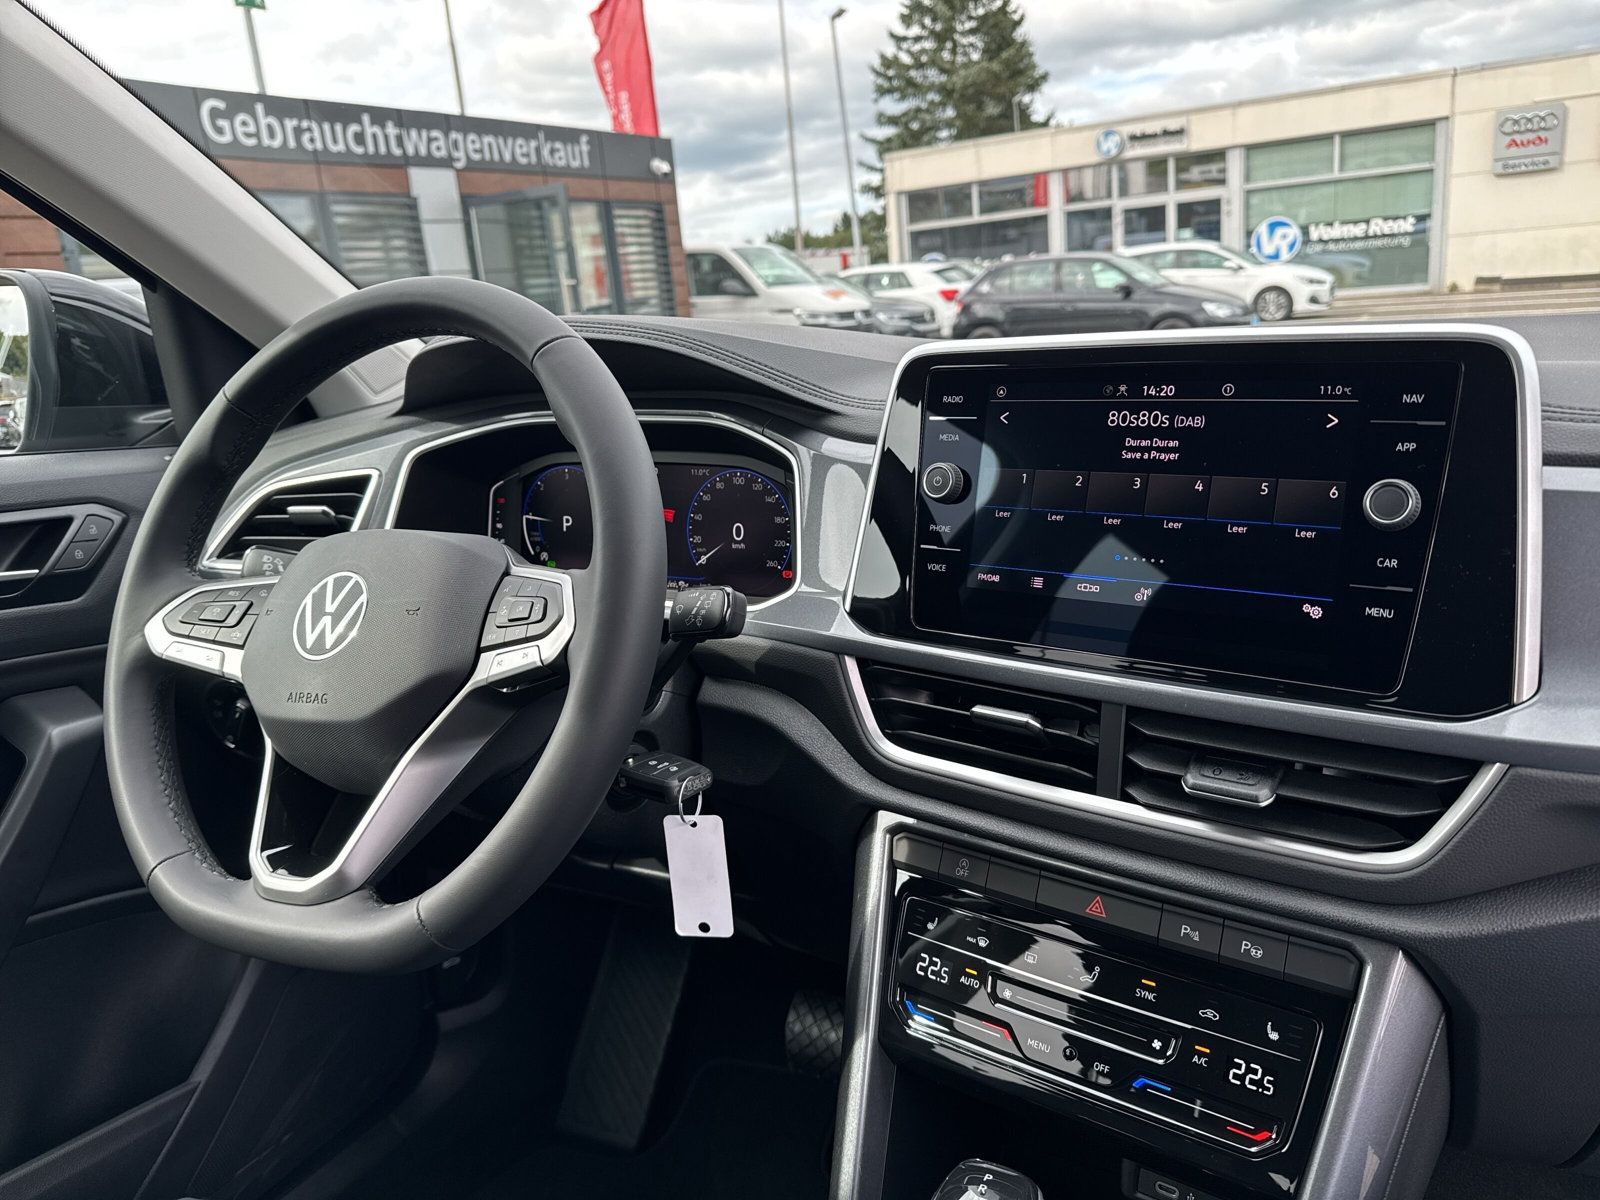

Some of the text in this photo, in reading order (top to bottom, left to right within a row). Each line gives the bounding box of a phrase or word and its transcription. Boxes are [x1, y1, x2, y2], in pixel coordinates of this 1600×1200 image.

[200, 98, 590, 169] Gebrauchtwagenverkauf
[1504, 134, 1549, 150] Audi
[1308, 215, 1417, 241] Volme Rent
[1142, 385, 1175, 396] 14:20
[942, 395, 964, 403] RADIO
[1402, 393, 1425, 404] NAV
[1107, 410, 1206, 429] 80s80s (DAB)
[939, 433, 960, 442] MEDIA
[1125, 437, 1179, 448] Duran Duran
[1395, 442, 1417, 452] APP
[1121, 450, 1180, 462] Save a Prayer
[732, 477, 745, 485] 100
[1021, 473, 1027, 484] 1
[1075, 475, 1083, 487] 2
[1132, 477, 1141, 489] 3
[1194, 480, 1204, 492] 4
[1260, 482, 1269, 495] 5
[1329, 485, 1339, 499] 6
[765, 495, 776, 503] 140
[995, 509, 1011, 518] Leer
[1047, 513, 1064, 522] Leer
[562, 515, 573, 532] P
[774, 516, 785, 524] 180
[1103, 516, 1121, 526] Leer
[1163, 520, 1183, 529] Leer
[732, 522, 744, 541] 0
[929, 524, 951, 533] PHONE
[1227, 524, 1248, 534] Leer
[1295, 528, 1316, 539] Leer
[693, 535, 702, 543] 20
[766, 560, 778, 568] 260
[927, 563, 946, 572] VOICE
[1376, 557, 1398, 568] CAR
[977, 573, 1000, 582] FM/DAB
[1364, 606, 1394, 618] MENU
[286, 692, 328, 704] AIRBAG
[955, 867, 969, 877] OFF
[966, 935, 976, 943] MAX
[916, 953, 949, 983] 22.5
[959, 975, 980, 989] AUTO
[1135, 988, 1158, 1002] SYNC
[1027, 1037, 1051, 1053] MENU
[1191, 1054, 1209, 1067] A/C
[1093, 1061, 1111, 1074] OFF
[1228, 1057, 1274, 1095] 22.5
[983, 1173, 994, 1181] P
[977, 1183, 988, 1194] R
